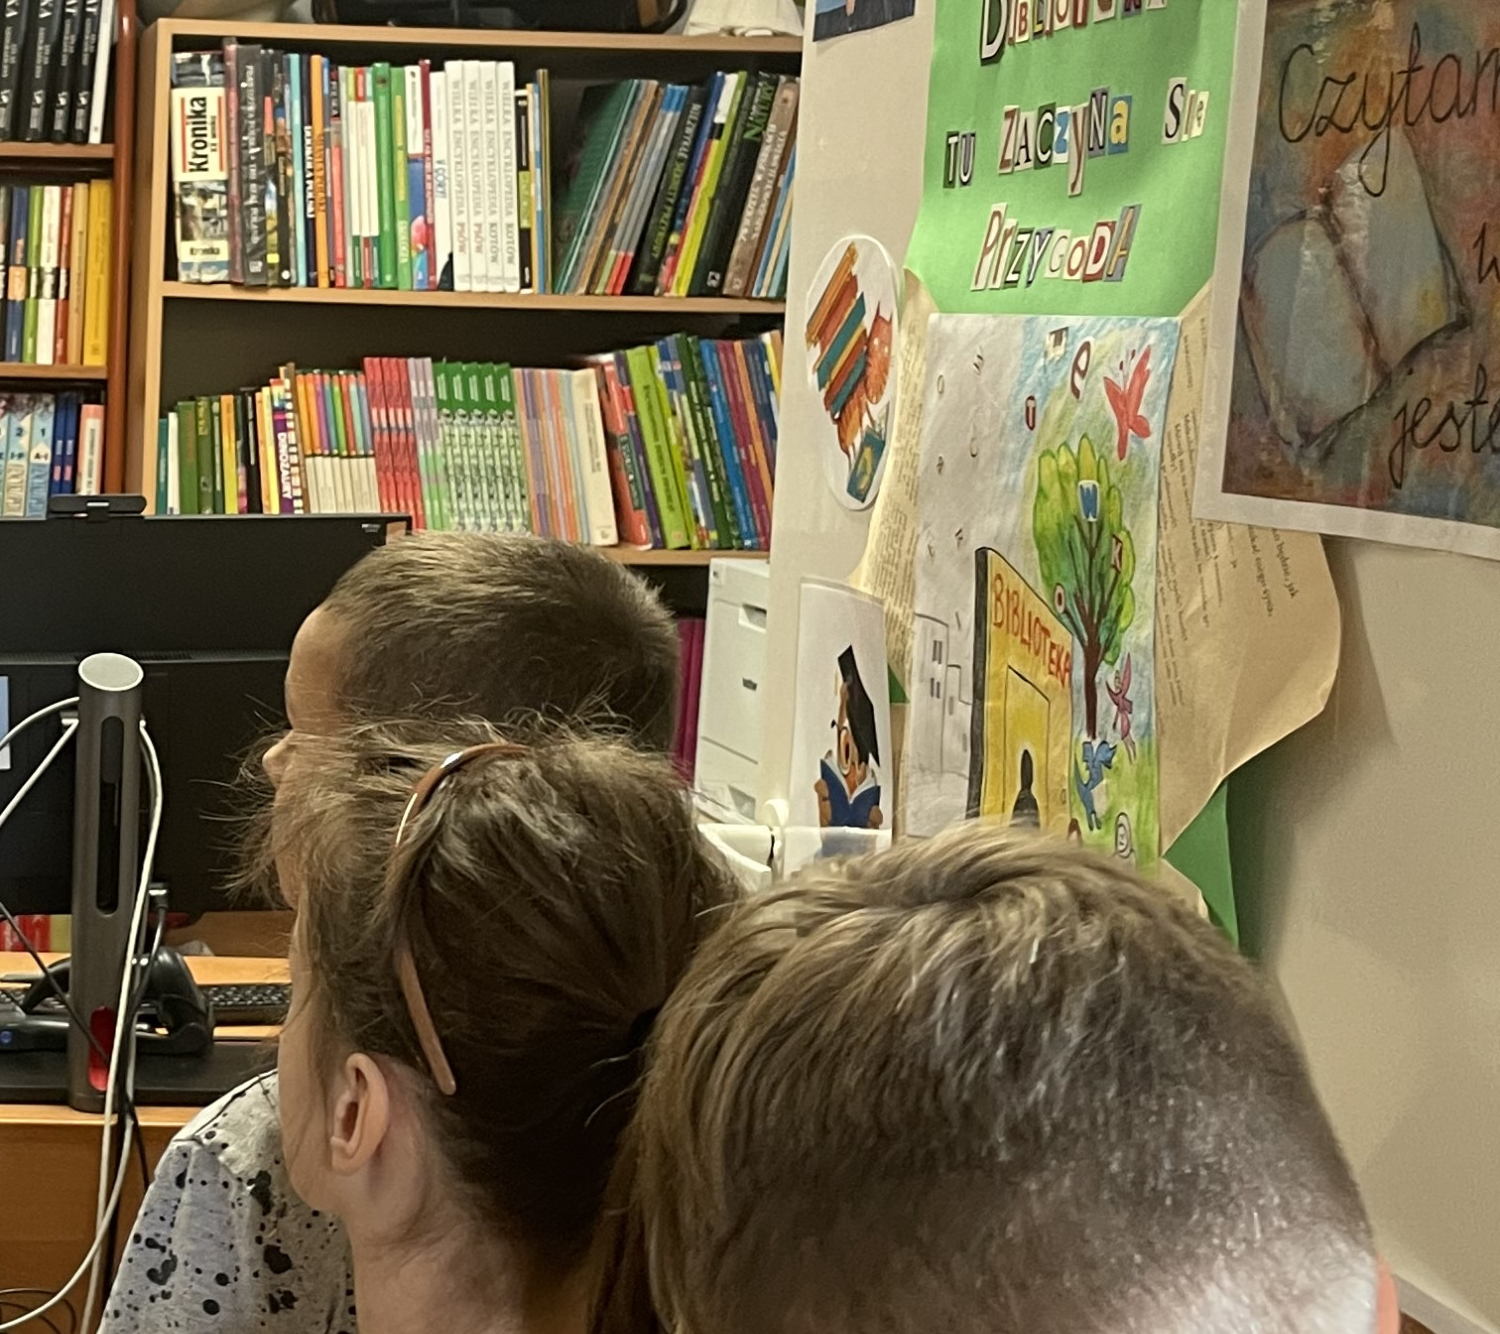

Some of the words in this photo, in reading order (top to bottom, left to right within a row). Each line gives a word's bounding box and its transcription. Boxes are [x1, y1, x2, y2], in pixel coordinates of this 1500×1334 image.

[188, 96, 208, 173] Kronika
[945, 133, 975, 185] TU
[15, 426, 24, 437] 2
[277, 432, 293, 499] DINOZAURY
[992, 572, 1073, 689] BIBLIOTEKA
